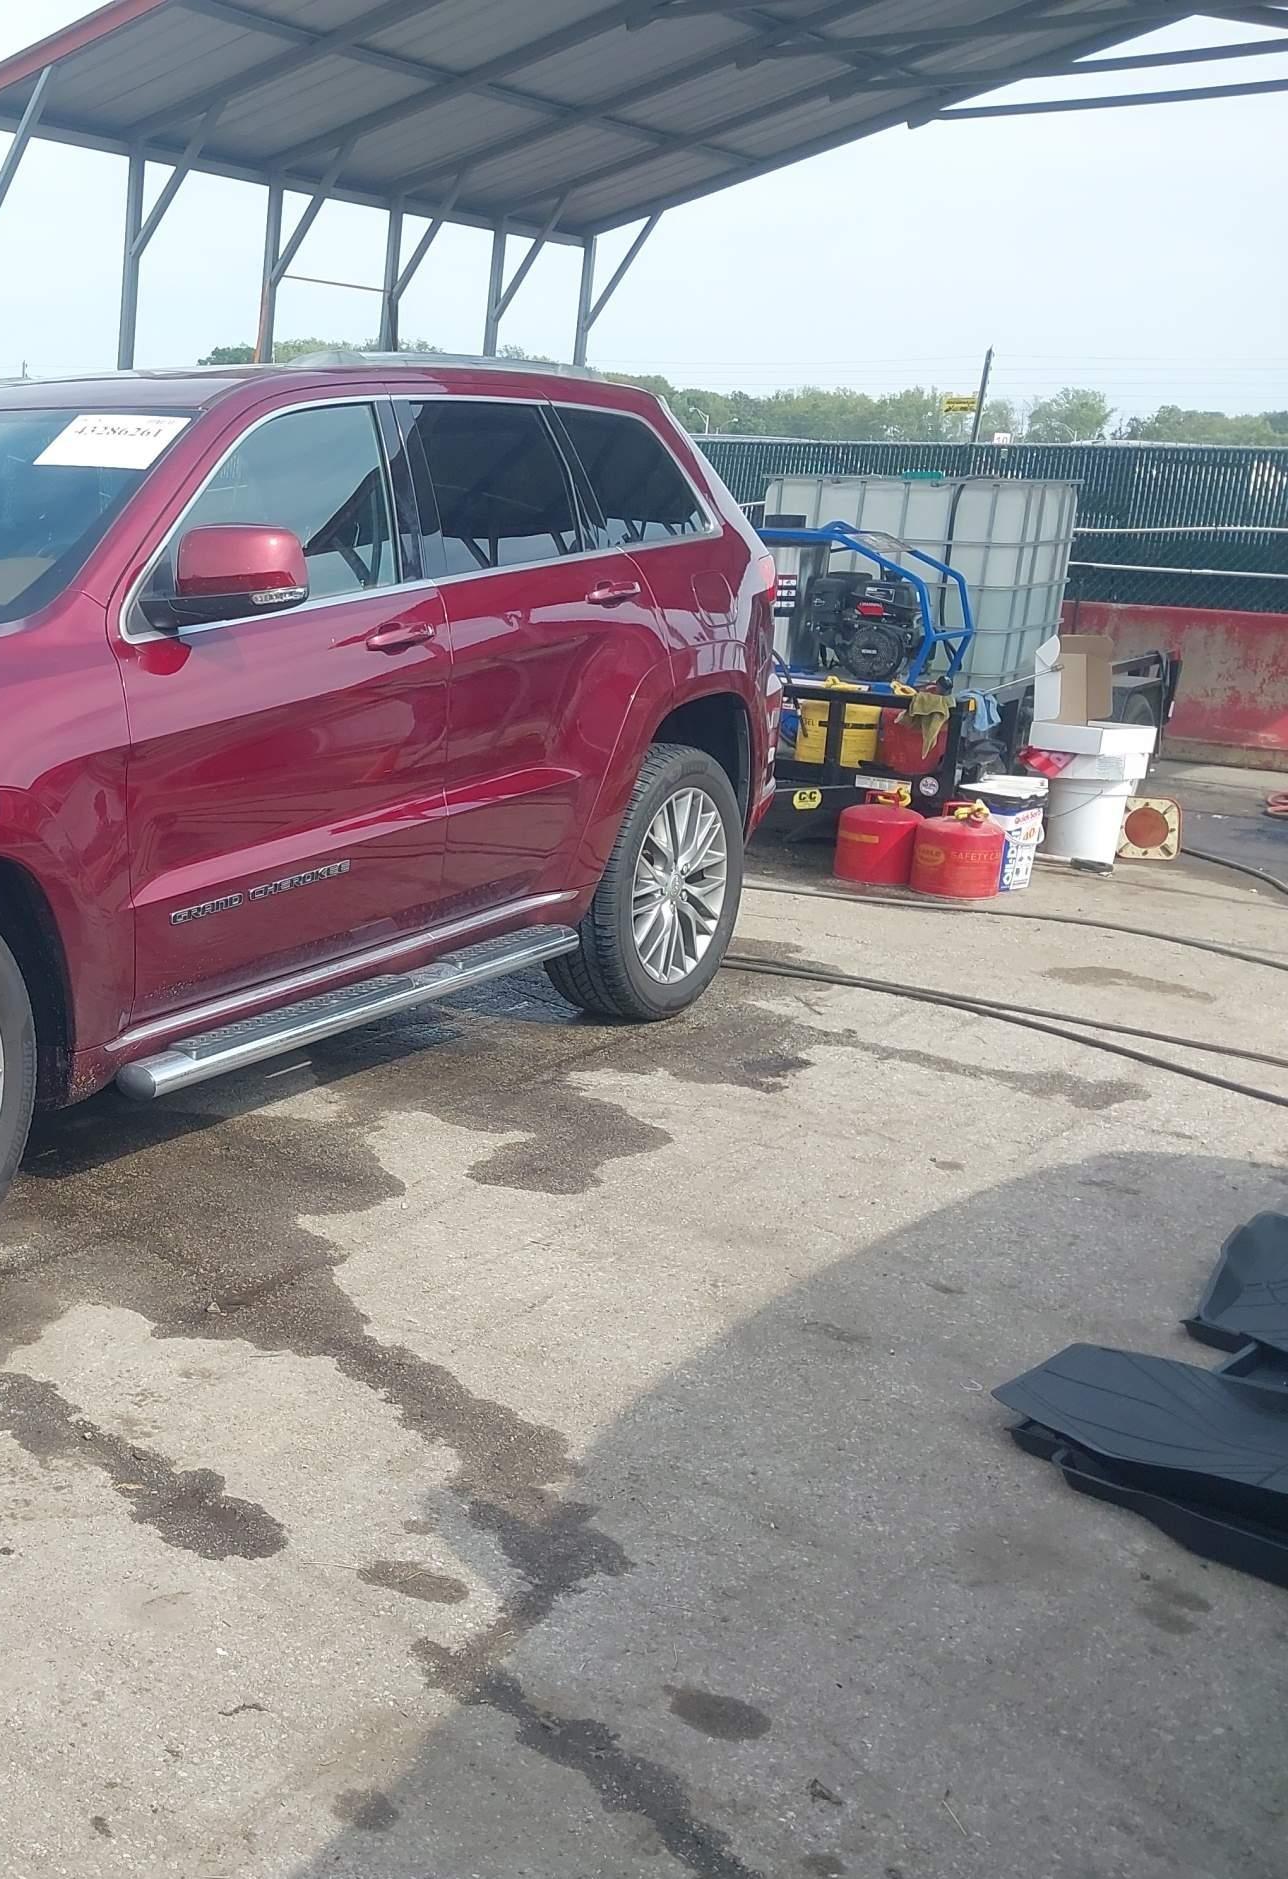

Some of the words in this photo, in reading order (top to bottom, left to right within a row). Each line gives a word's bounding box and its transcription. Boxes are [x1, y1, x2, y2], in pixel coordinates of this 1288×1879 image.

[951, 850, 987, 862] SAFETY
[170, 892, 244, 926] GRAND
[249, 858, 352, 901] CHEROKEE
